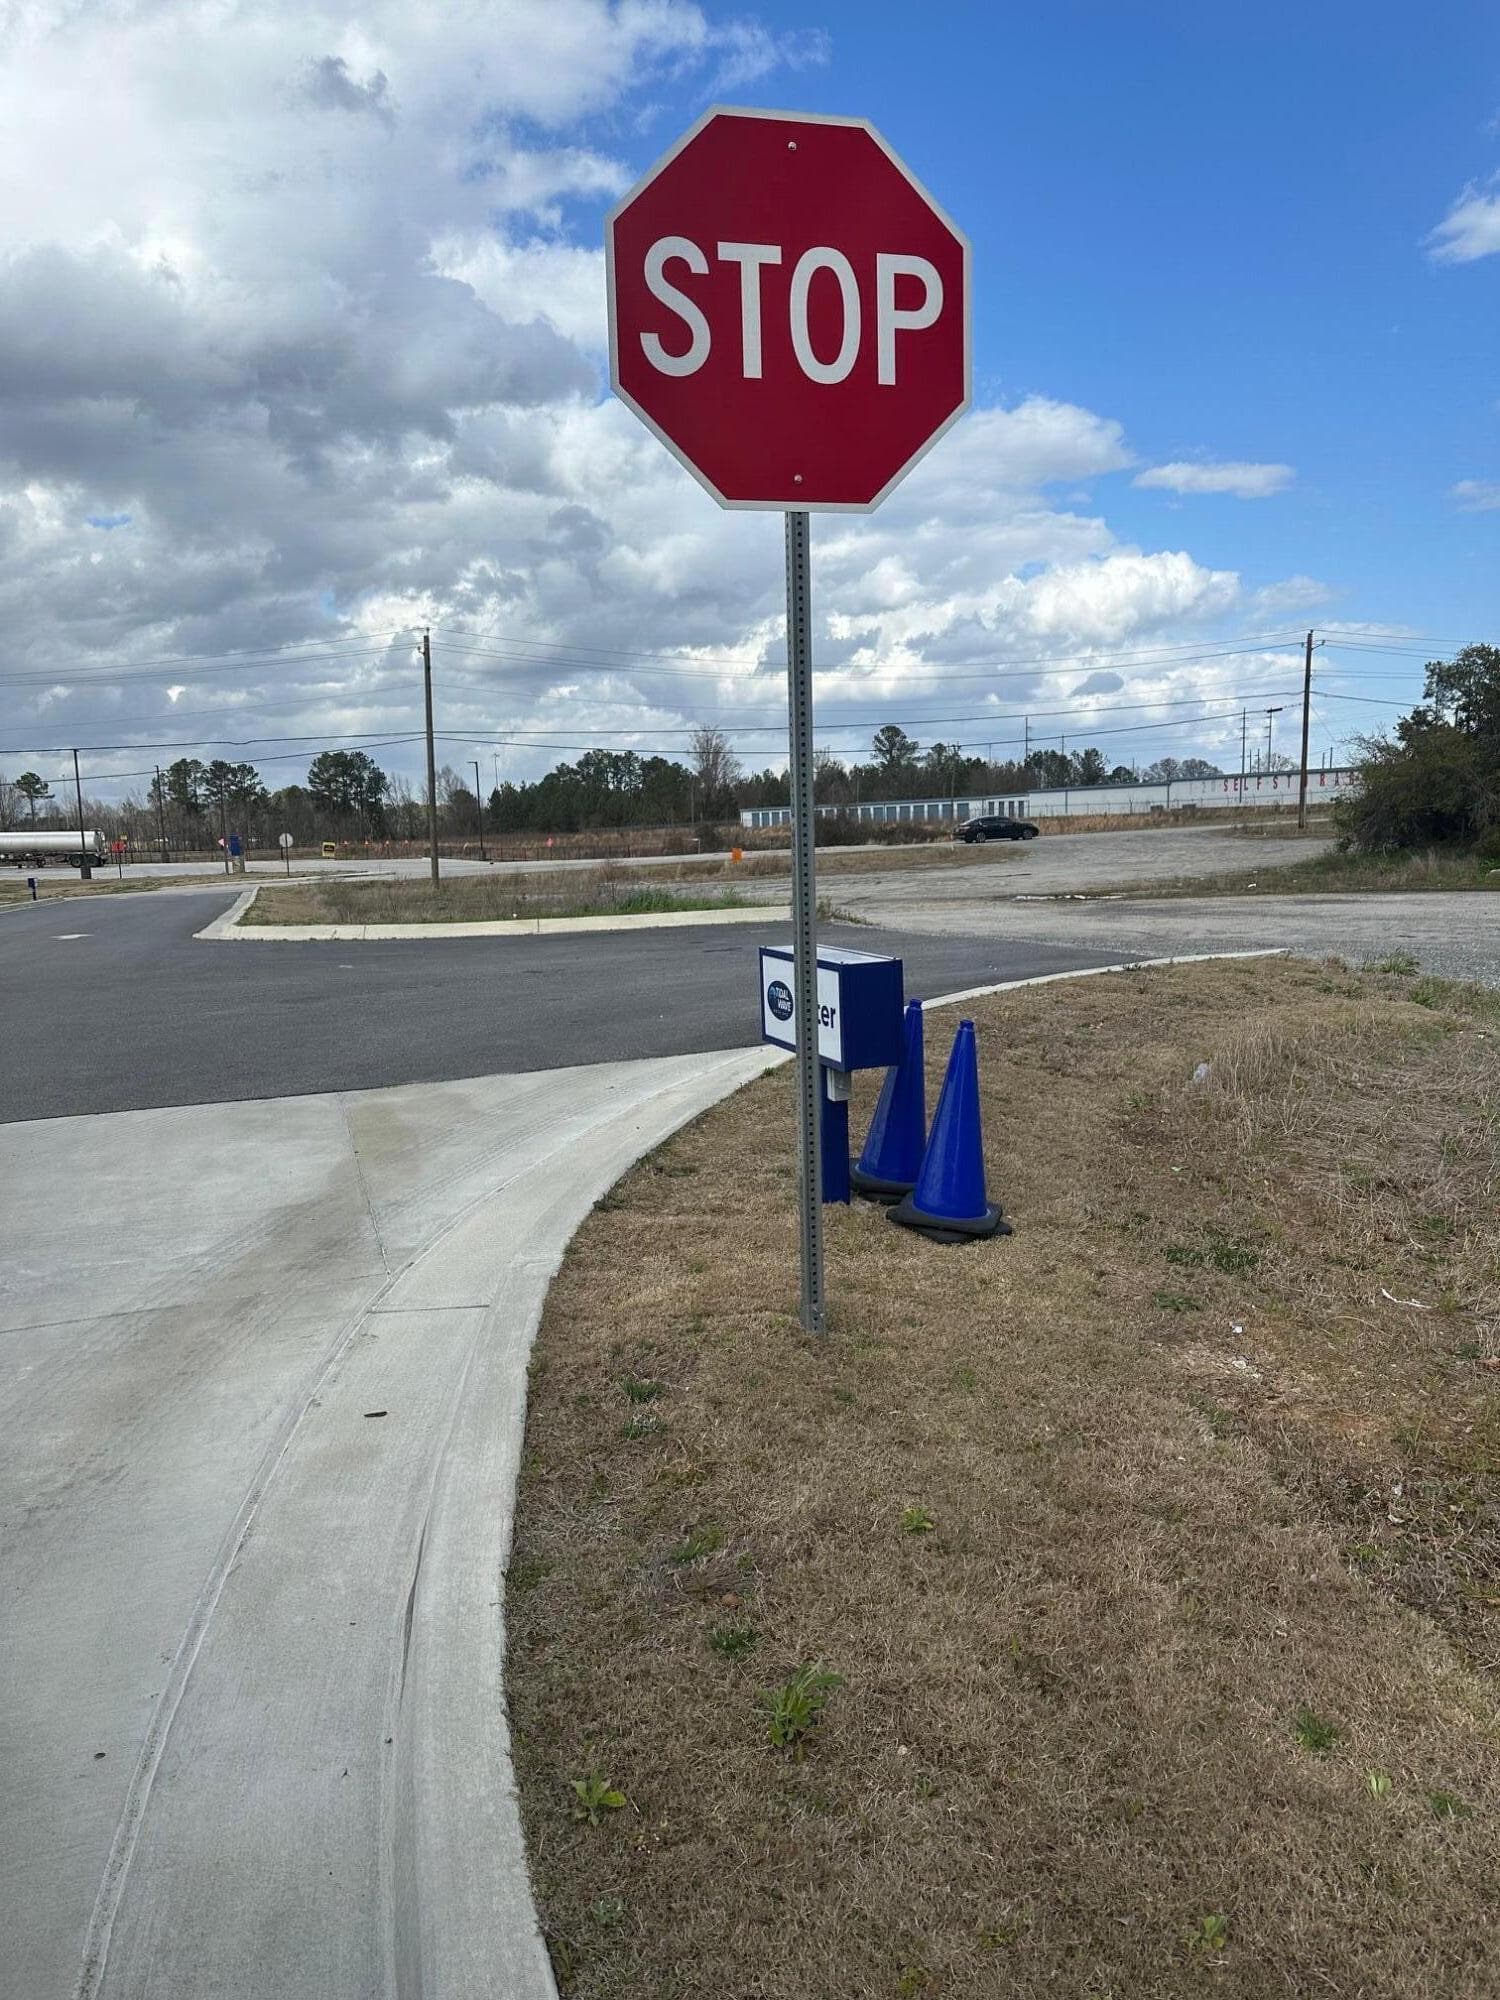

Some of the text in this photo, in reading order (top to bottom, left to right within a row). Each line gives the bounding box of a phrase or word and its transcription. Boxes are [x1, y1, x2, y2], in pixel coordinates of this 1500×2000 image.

[640, 236, 944, 386] STOP
[1223, 775, 1263, 793] SELF
[1272, 771, 1355, 790] STRA
[775, 987, 790, 1001] TIDAL
[778, 999, 792, 1012] WAVE
